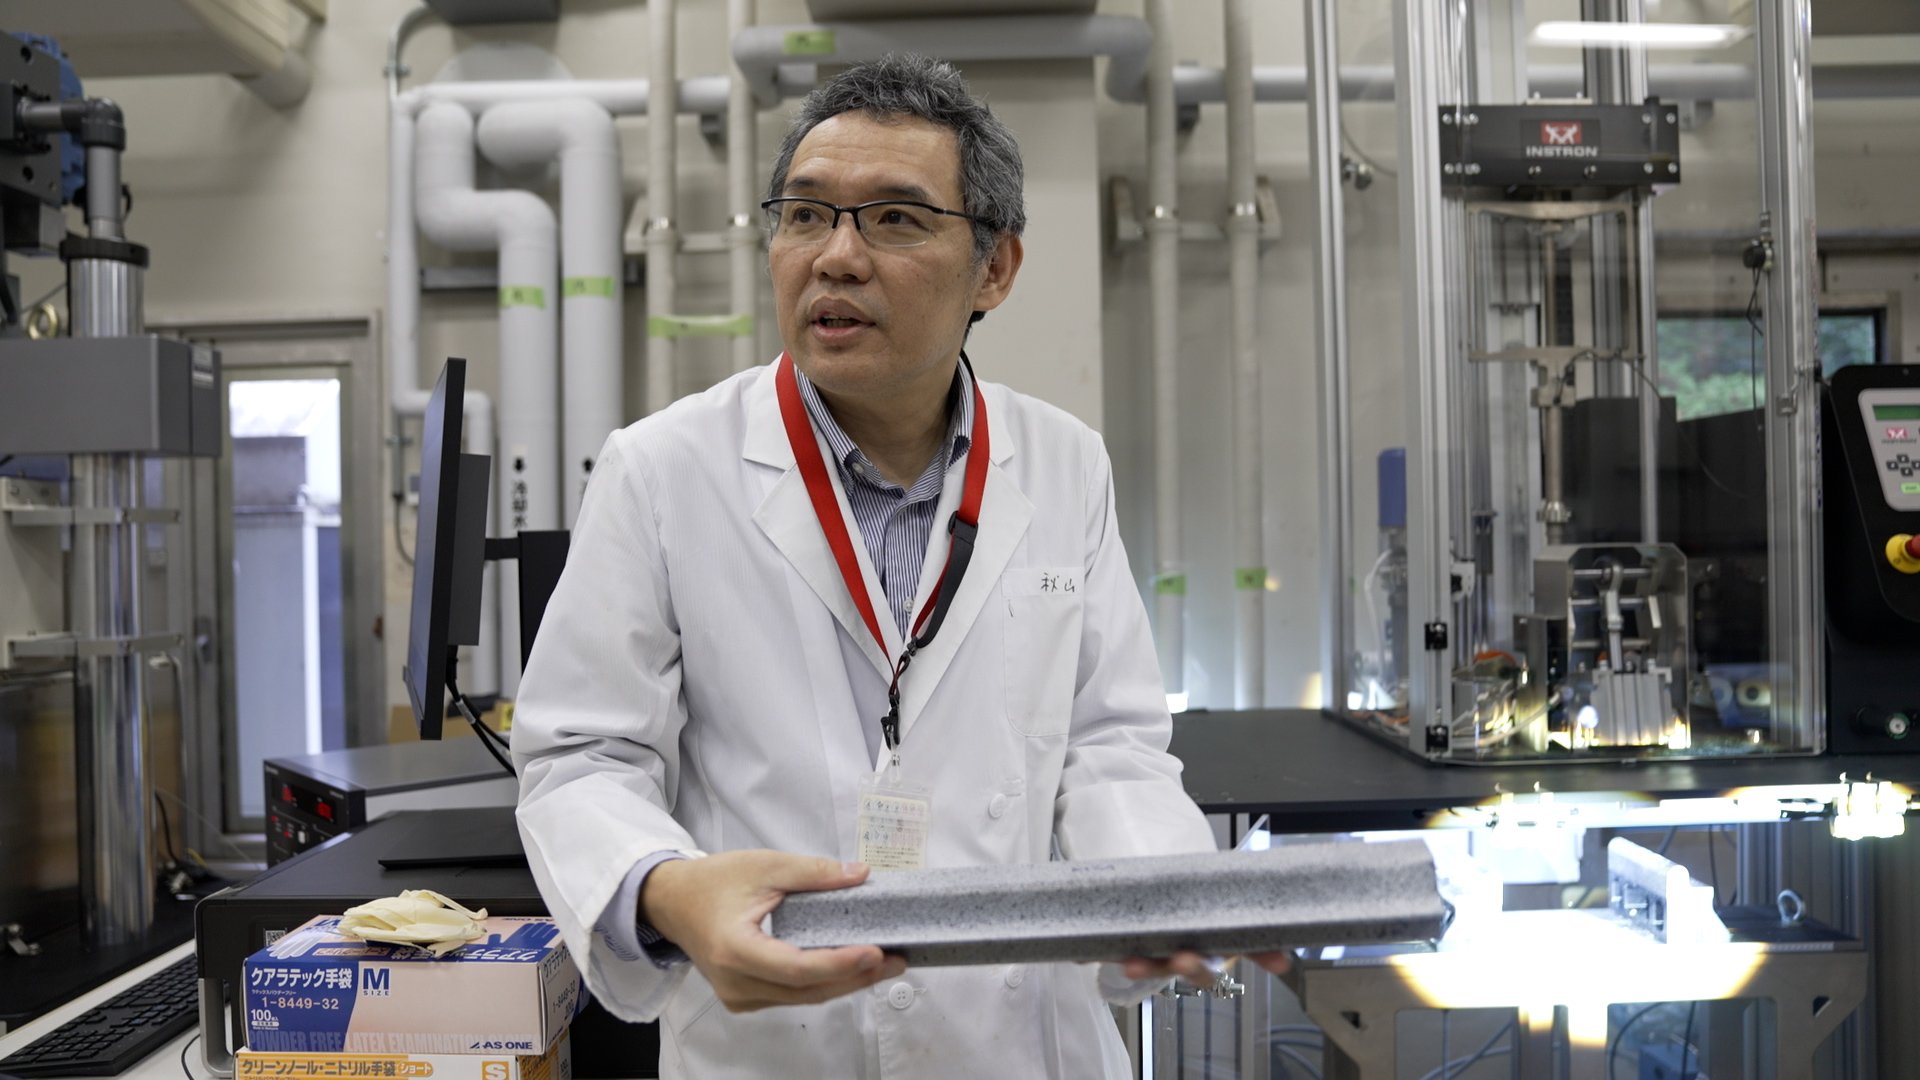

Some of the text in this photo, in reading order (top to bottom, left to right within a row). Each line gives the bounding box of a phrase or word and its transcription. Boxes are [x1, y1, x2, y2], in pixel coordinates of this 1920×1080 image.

[1525, 146, 1598, 157] INSTRON
[1040, 572, 1075, 592] 秋山
[251, 967, 352, 988] クアラテック手袋
[363, 968, 390, 989] M
[261, 997, 339, 1009] 1-8449-32
[249, 1031, 306, 1051] POWDER
[309, 1031, 341, 1051] FREE
[347, 1032, 387, 1053] LATEX
[483, 1041, 533, 1049] AS ONE
[242, 1060, 396, 1076] クリーンノール・ニトリル手袋
[401, 1061, 432, 1074] ショート
[484, 1063, 507, 1080] S
